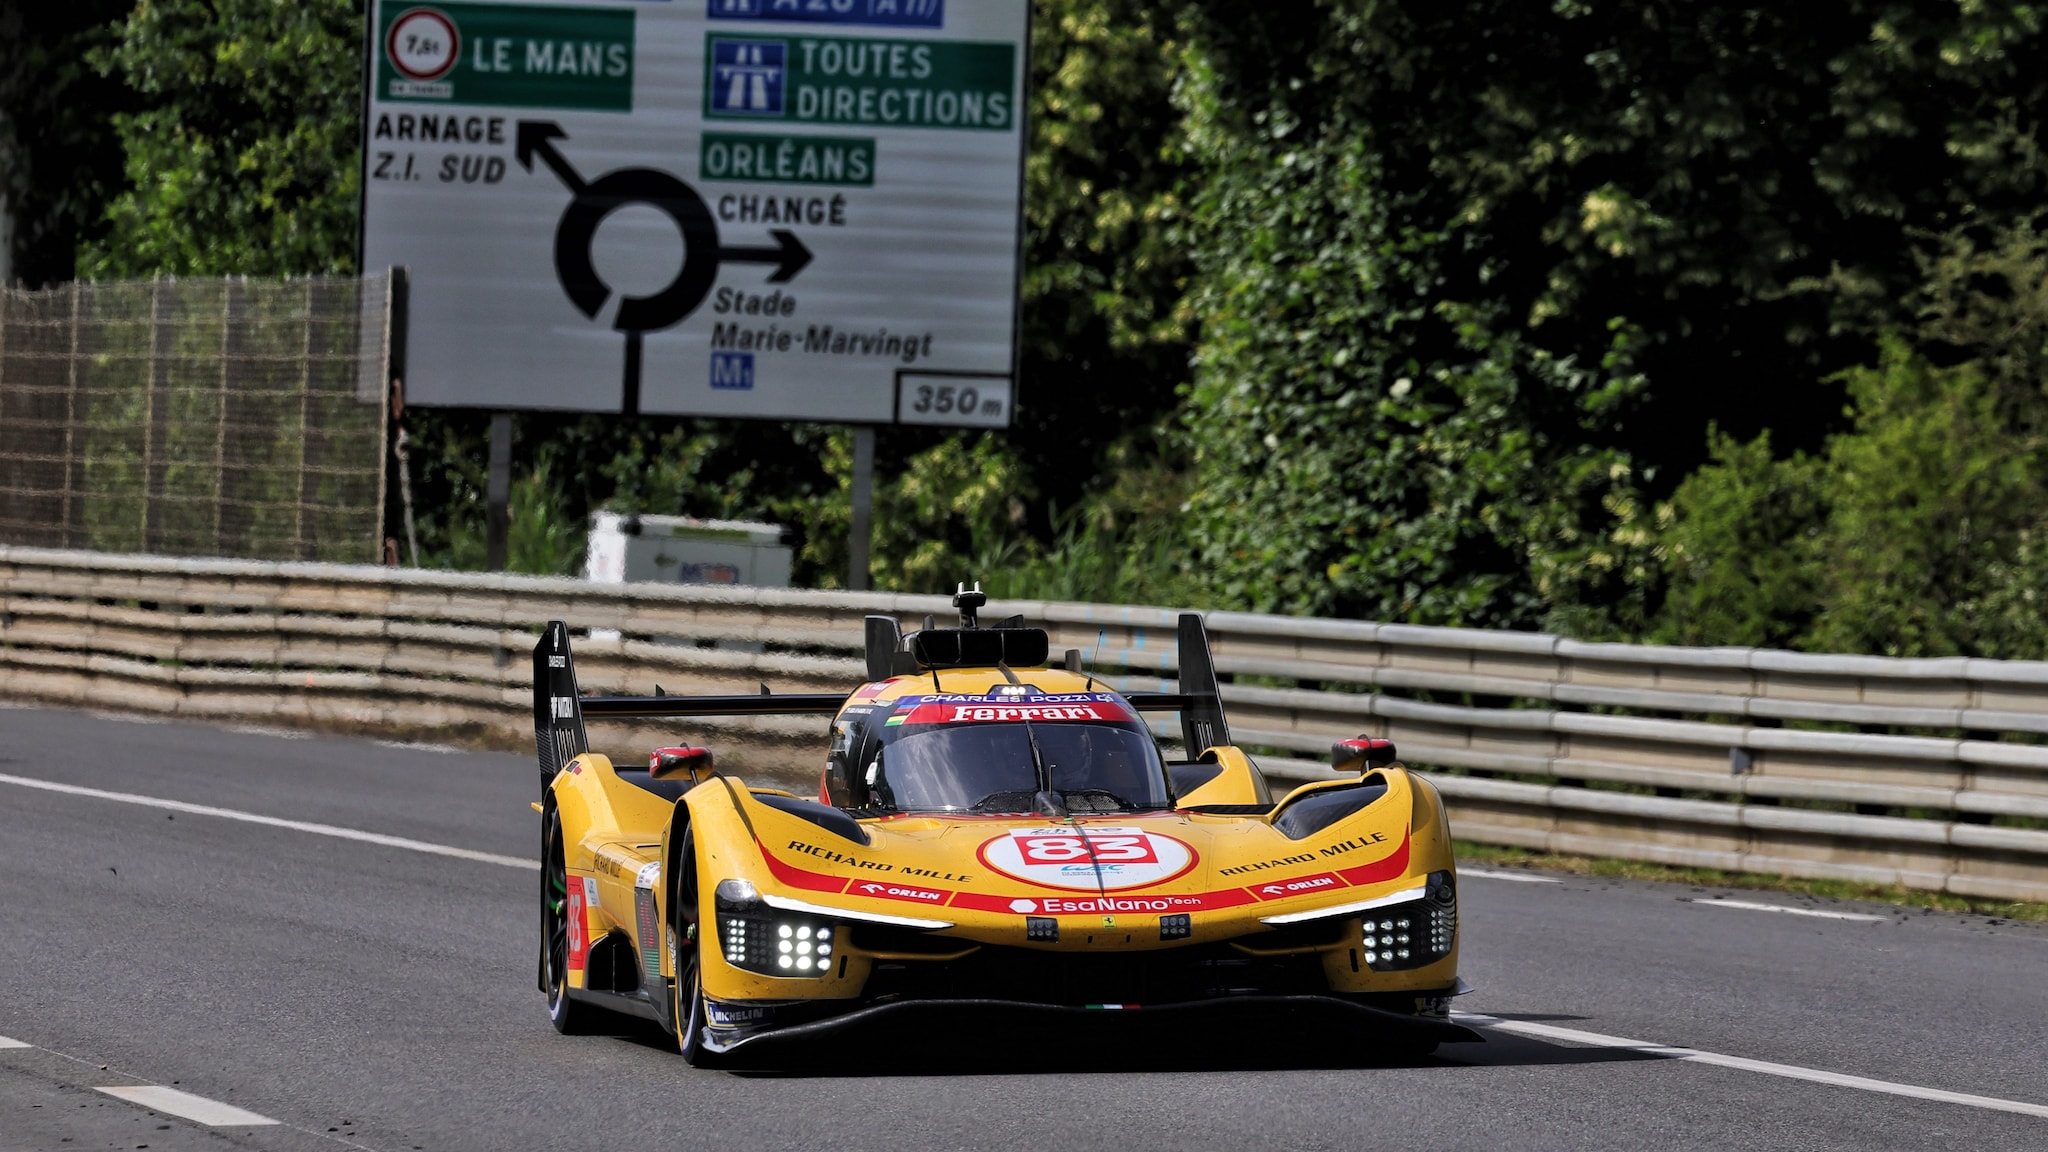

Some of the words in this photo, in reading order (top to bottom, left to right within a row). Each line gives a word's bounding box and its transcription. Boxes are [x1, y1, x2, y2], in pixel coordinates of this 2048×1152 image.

[472, 37, 512, 73] LE
[525, 40, 628, 77] MANS
[801, 40, 932, 79] TOUTES
[796, 85, 1009, 127] DIRECTIONS
[374, 113, 507, 144] ARNAGE
[372, 152, 421, 182] Z.I.
[438, 154, 506, 184] SUD
[705, 138, 869, 181] ORLÉANS
[717, 194, 847, 226] CHANGÉ
[712, 286, 797, 317] Stade
[710, 321, 934, 364] Marie-Marvingt
[920, 694, 1021, 704] CHARLES
[1030, 695, 1091, 703] POZZI
[949, 704, 1103, 722] Ferrari
[787, 840, 893, 872] RICHARD
[900, 866, 974, 883] MILLE
[1025, 837, 1149, 861] 83
[1218, 853, 1316, 876] RICHARD
[1320, 831, 1388, 857] MILLE
[887, 887, 941, 900] ORLEN
[1286, 877, 1335, 891] ORLEN
[714, 1007, 764, 1022] MICHELIN
